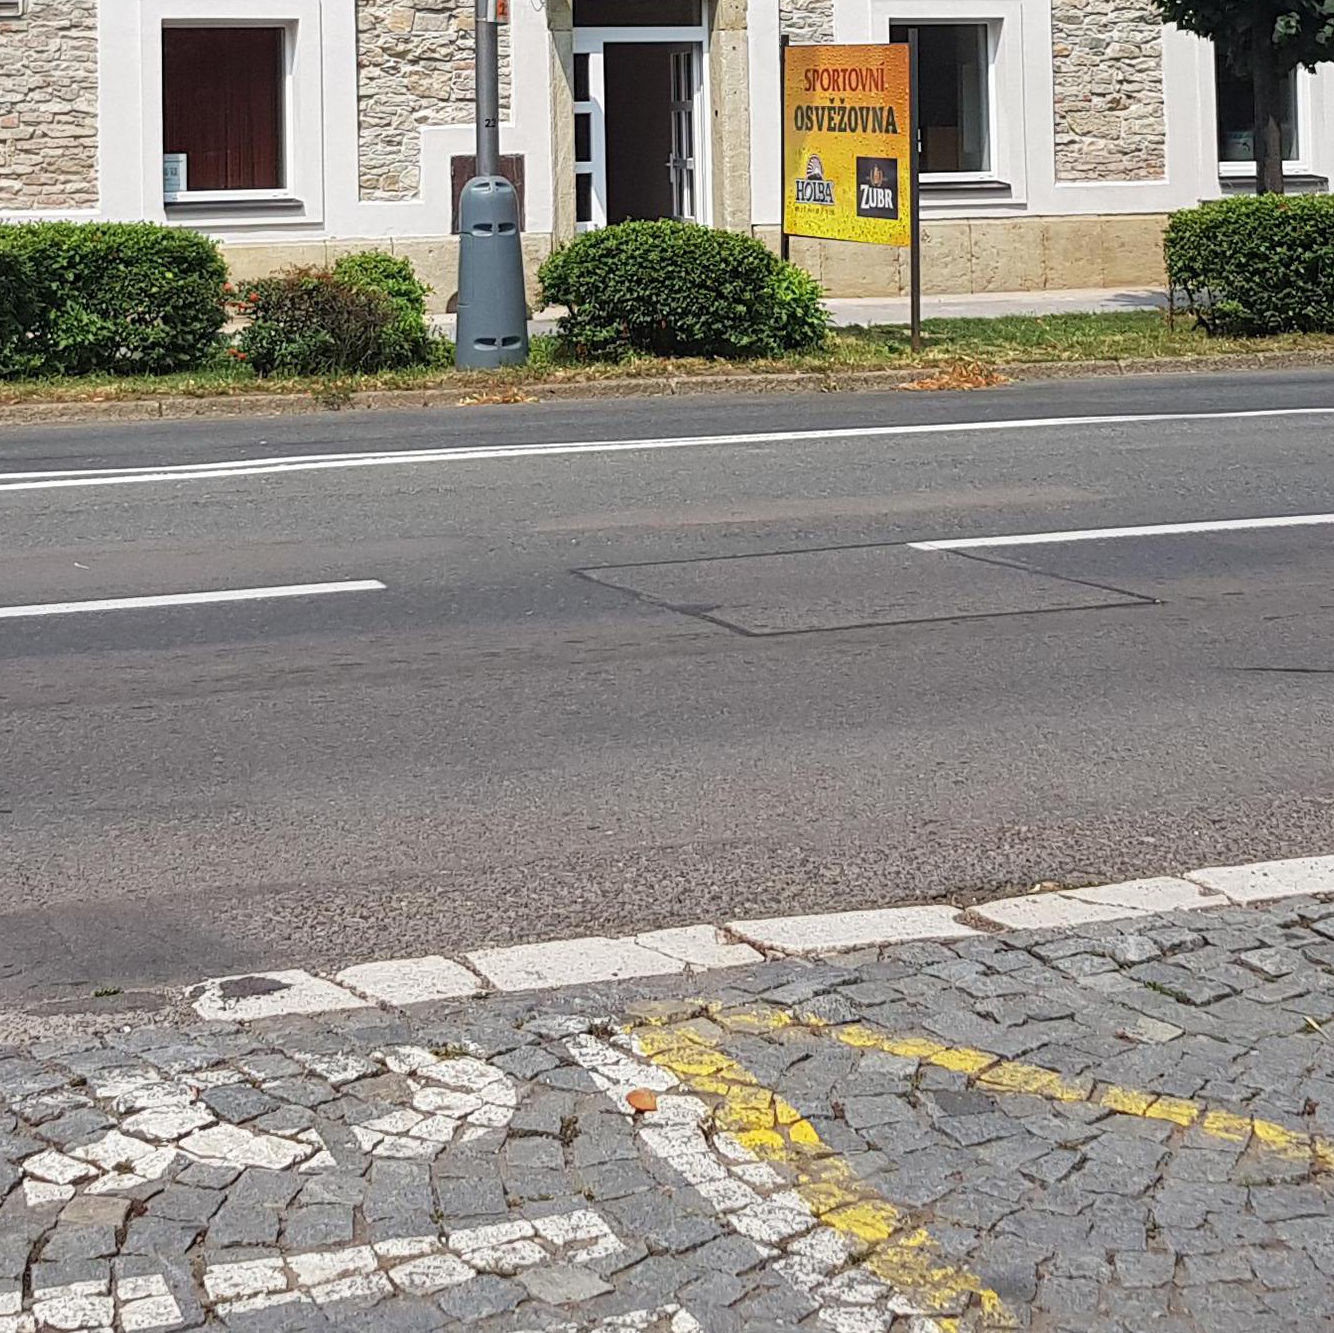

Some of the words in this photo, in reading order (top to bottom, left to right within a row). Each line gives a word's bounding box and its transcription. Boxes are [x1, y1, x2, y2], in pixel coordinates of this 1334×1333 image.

[804, 62, 885, 92] SPORTOVNÍ
[794, 97, 899, 135] OSVĚŽOVNA
[795, 180, 835, 204] HOLBA
[860, 184, 894, 210] ZUBR
